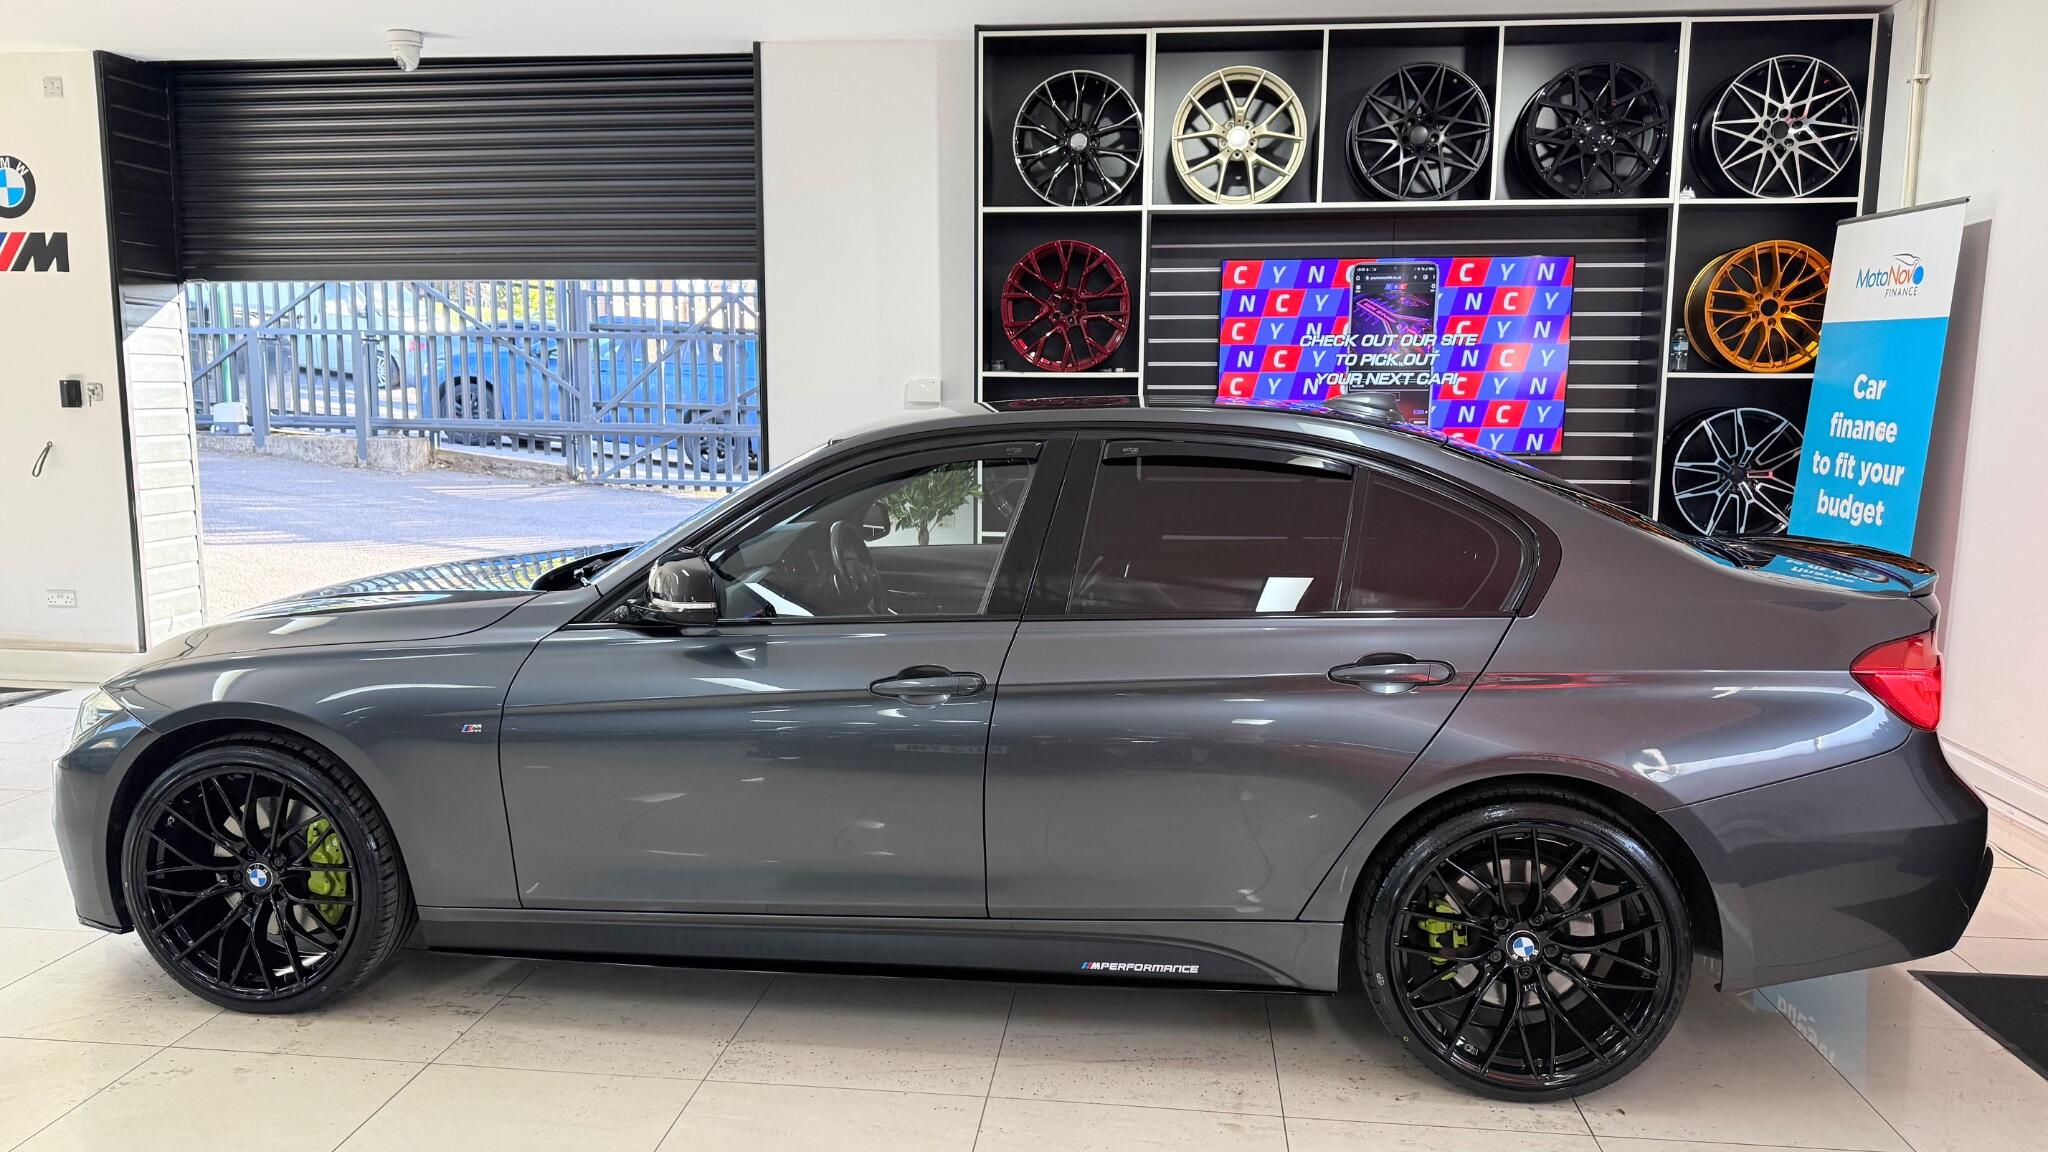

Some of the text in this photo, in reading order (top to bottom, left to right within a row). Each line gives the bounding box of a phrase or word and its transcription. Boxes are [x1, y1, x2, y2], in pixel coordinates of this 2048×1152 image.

[0, 157, 29, 176] MW
[1233, 265, 1248, 284] C
[1272, 266, 1287, 284] Y
[1308, 265, 1325, 284] N
[1460, 263, 1475, 282] C
[1501, 263, 1516, 281] Y
[1537, 263, 1555, 281] N
[1884, 286, 1918, 299] FINANCE
[1239, 295, 1256, 313] N
[1275, 294, 1290, 313] C
[1315, 294, 1329, 312] Y
[1465, 293, 1482, 311] N
[1503, 292, 1518, 311] C
[1545, 292, 1560, 310] Y
[1231, 322, 1246, 341] C
[1270, 323, 1284, 340] Y
[1497, 321, 1512, 339] Y
[1533, 321, 1551, 339] N
[1299, 333, 1479, 347] CHECK OUT OUR SITE
[1237, 349, 1556, 368] N C Y N C Y
[1335, 353, 1440, 366] TO PICK OUT
[1229, 377, 1243, 395] C
[1268, 378, 1282, 395] Y
[1493, 377, 1508, 395] Y
[1529, 377, 1547, 395] N
[1316, 372, 1363, 385] YOUR
[1365, 372, 1415, 385] NEXT
[1853, 373, 1887, 400] Car
[1457, 405, 1552, 423] N C Y
[1829, 411, 1898, 443] finance
[1489, 433, 1544, 451] Y N
[1812, 450, 1905, 486] to fit your
[1816, 488, 1885, 527] budget
